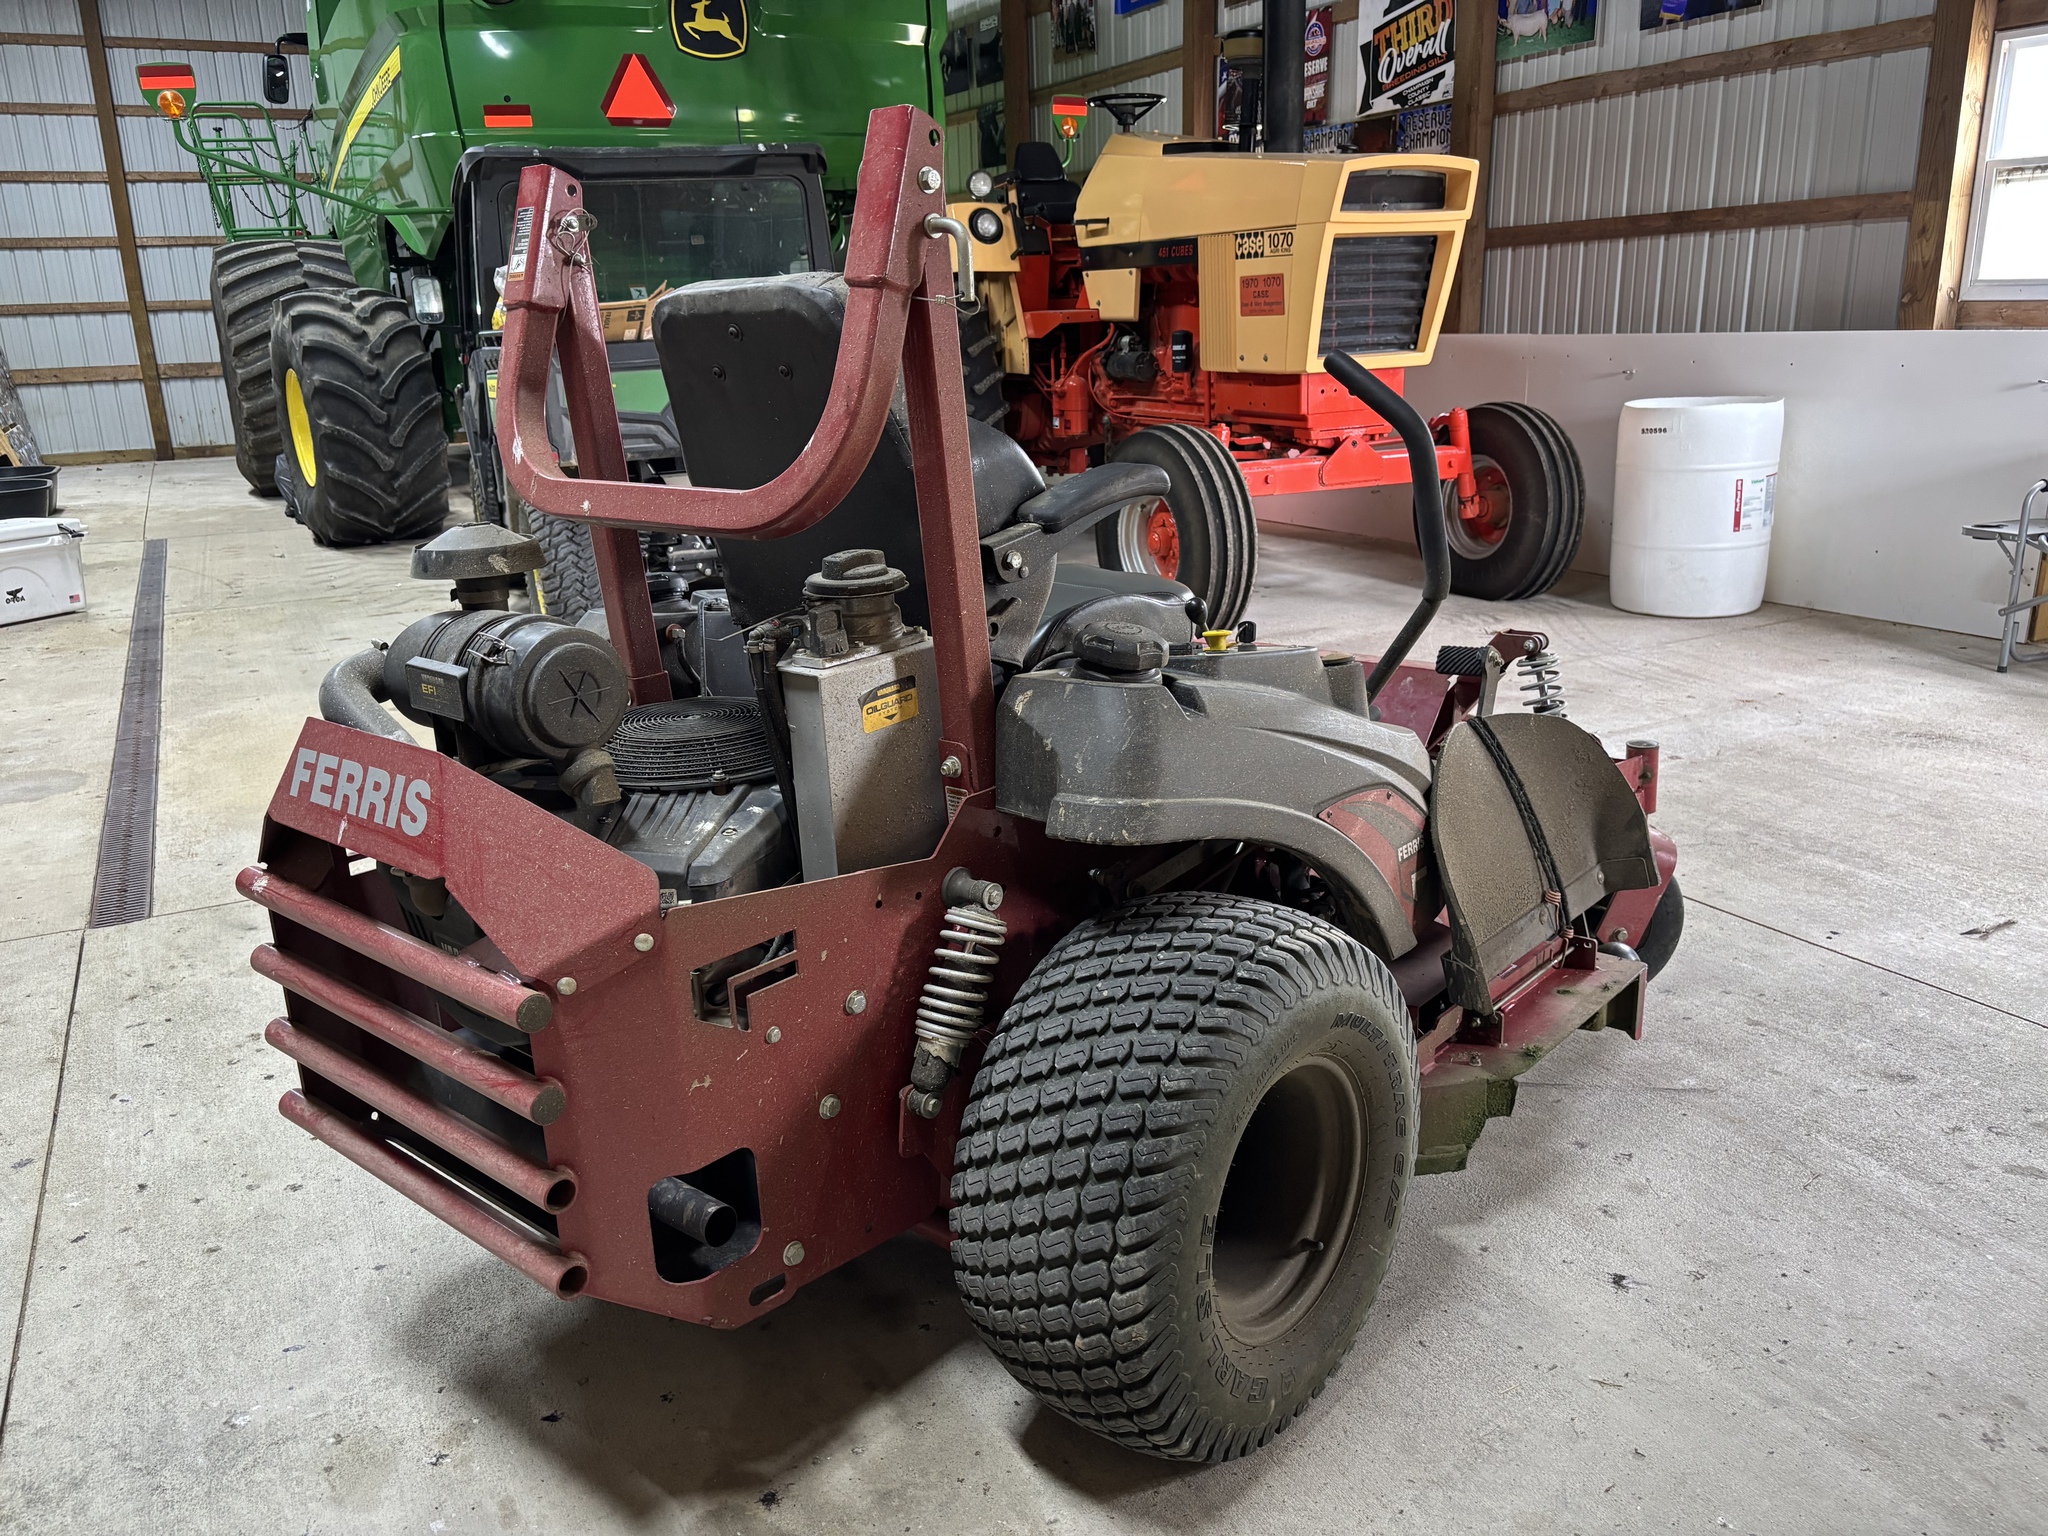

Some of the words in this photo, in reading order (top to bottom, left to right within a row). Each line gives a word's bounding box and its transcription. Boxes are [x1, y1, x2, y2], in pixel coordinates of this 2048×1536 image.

[1374, 0, 1453, 64] THIRD
[1378, 19, 1451, 83] Overall
[1304, 56, 1328, 77] ESERVE
[1382, 65, 1427, 91] BREEDING
[1427, 51, 1448, 68] GILT
[1407, 85, 1430, 100] COUNTY
[1407, 91, 1431, 106] CLASSIC
[1406, 110, 1451, 132] RESERVE
[1268, 232, 1294, 248] 1070
[1158, 247, 1169, 258] 451
[1171, 244, 1194, 257] CUBES
[1241, 278, 1259, 289] 1970
[1262, 276, 1281, 288] 1070
[1253, 290, 1269, 298] CASE
[421, 683, 437, 695] EFI
[866, 693, 913, 715] OILGUARD
[289, 747, 431, 836] FERRIS
[1331, 1012, 1388, 1051] MULTI
[1382, 1050, 1406, 1137] TRAC
[1196, 1213, 1269, 1404] CARLISLE
